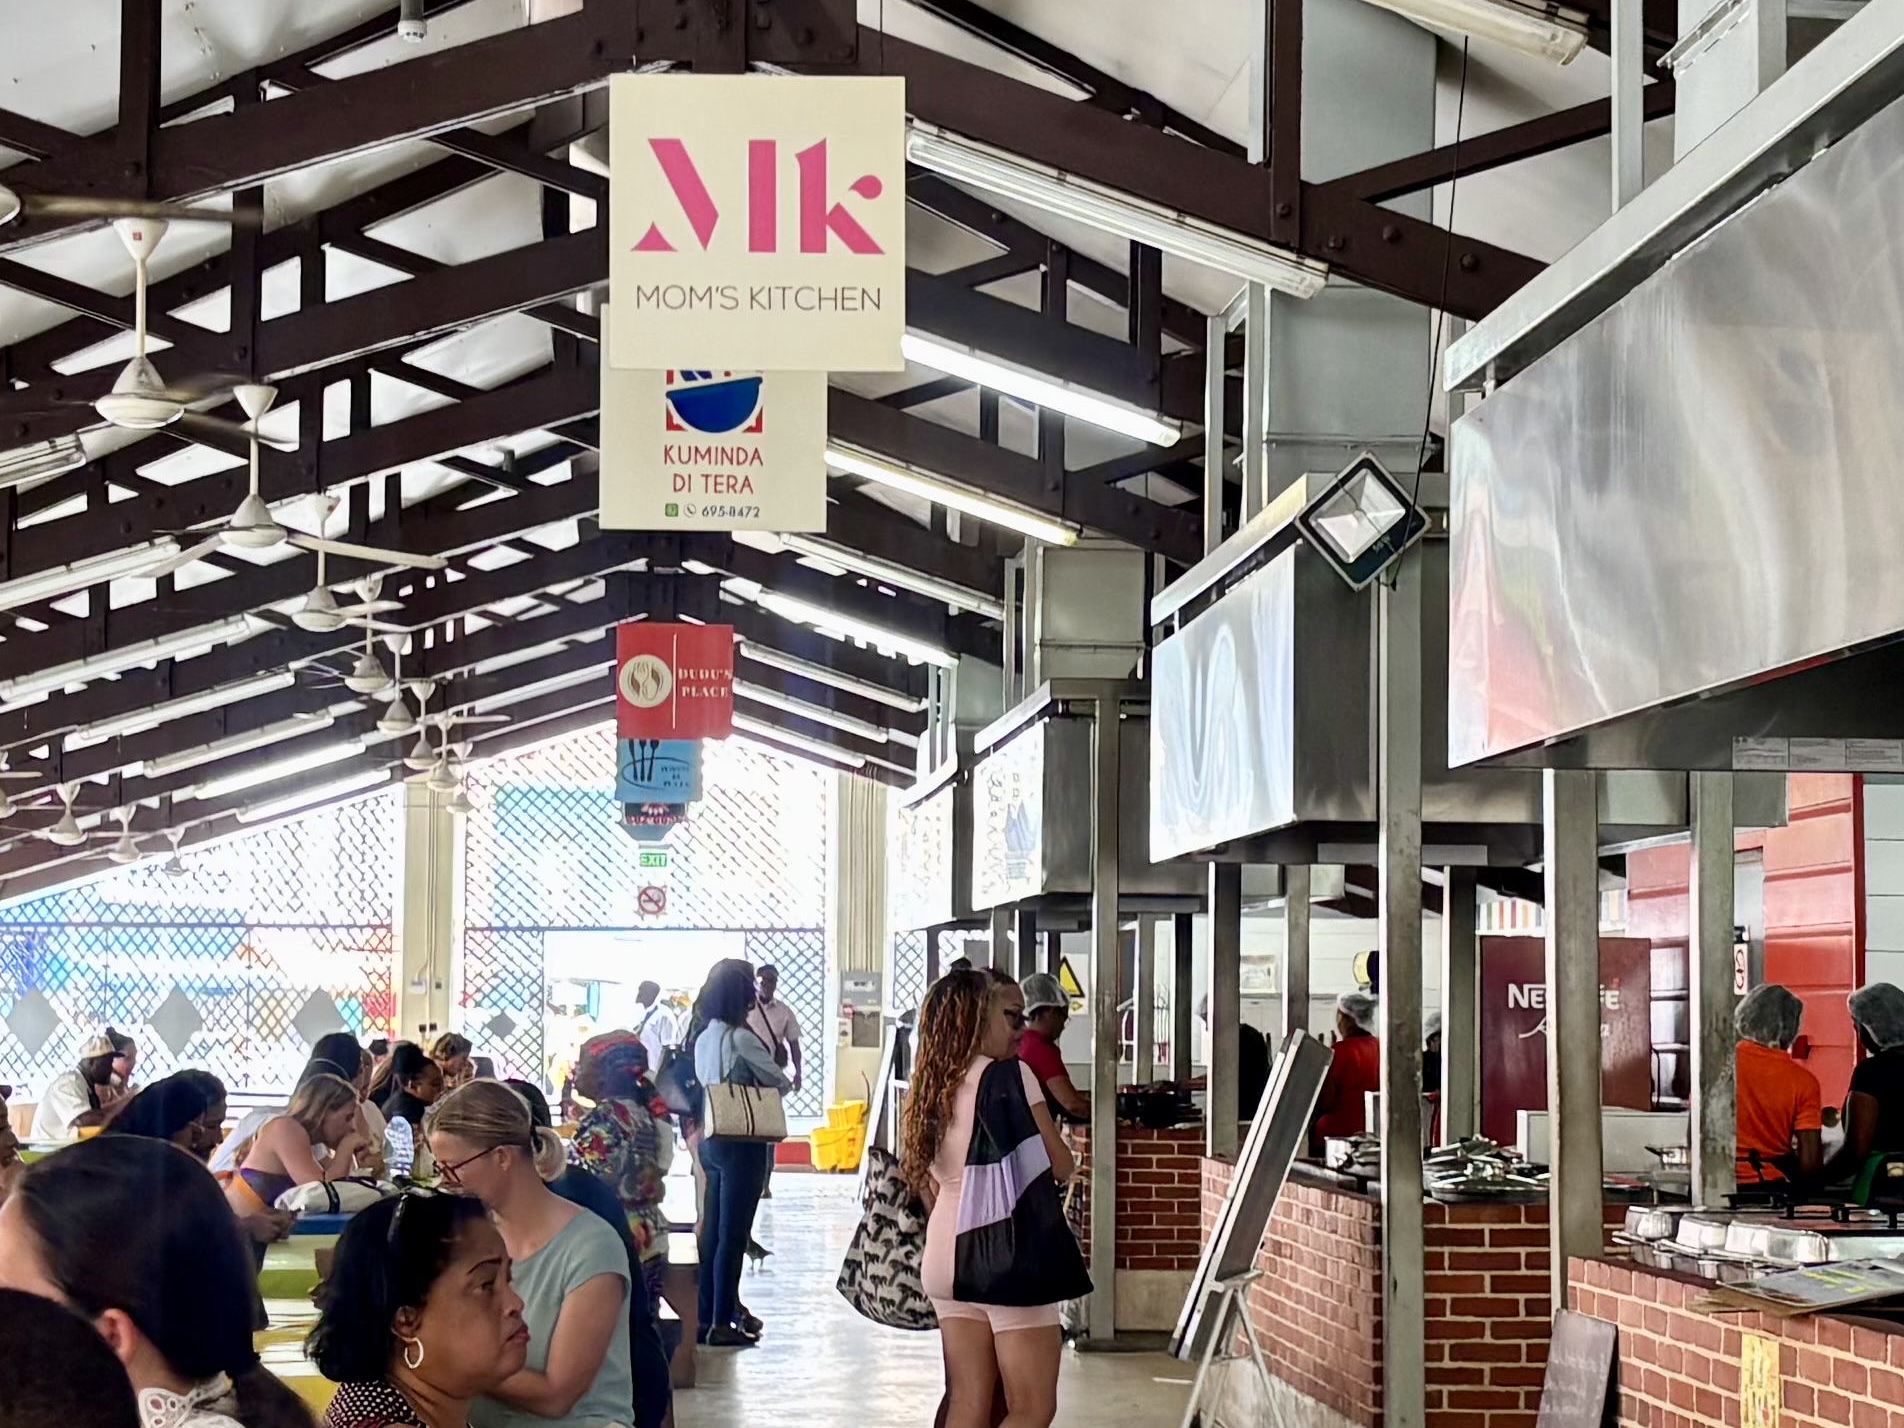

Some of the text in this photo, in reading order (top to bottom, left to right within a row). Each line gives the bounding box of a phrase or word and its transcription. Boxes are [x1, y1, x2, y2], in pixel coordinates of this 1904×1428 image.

[636, 284, 882, 312] MOM'S KITCHEN
[663, 444, 764, 466] KUMINDA
[672, 473, 754, 495] DI TERA
[677, 667, 733, 681] DUDU'S
[681, 685, 729, 698] PLACE
[641, 853, 667, 868] EXIT
